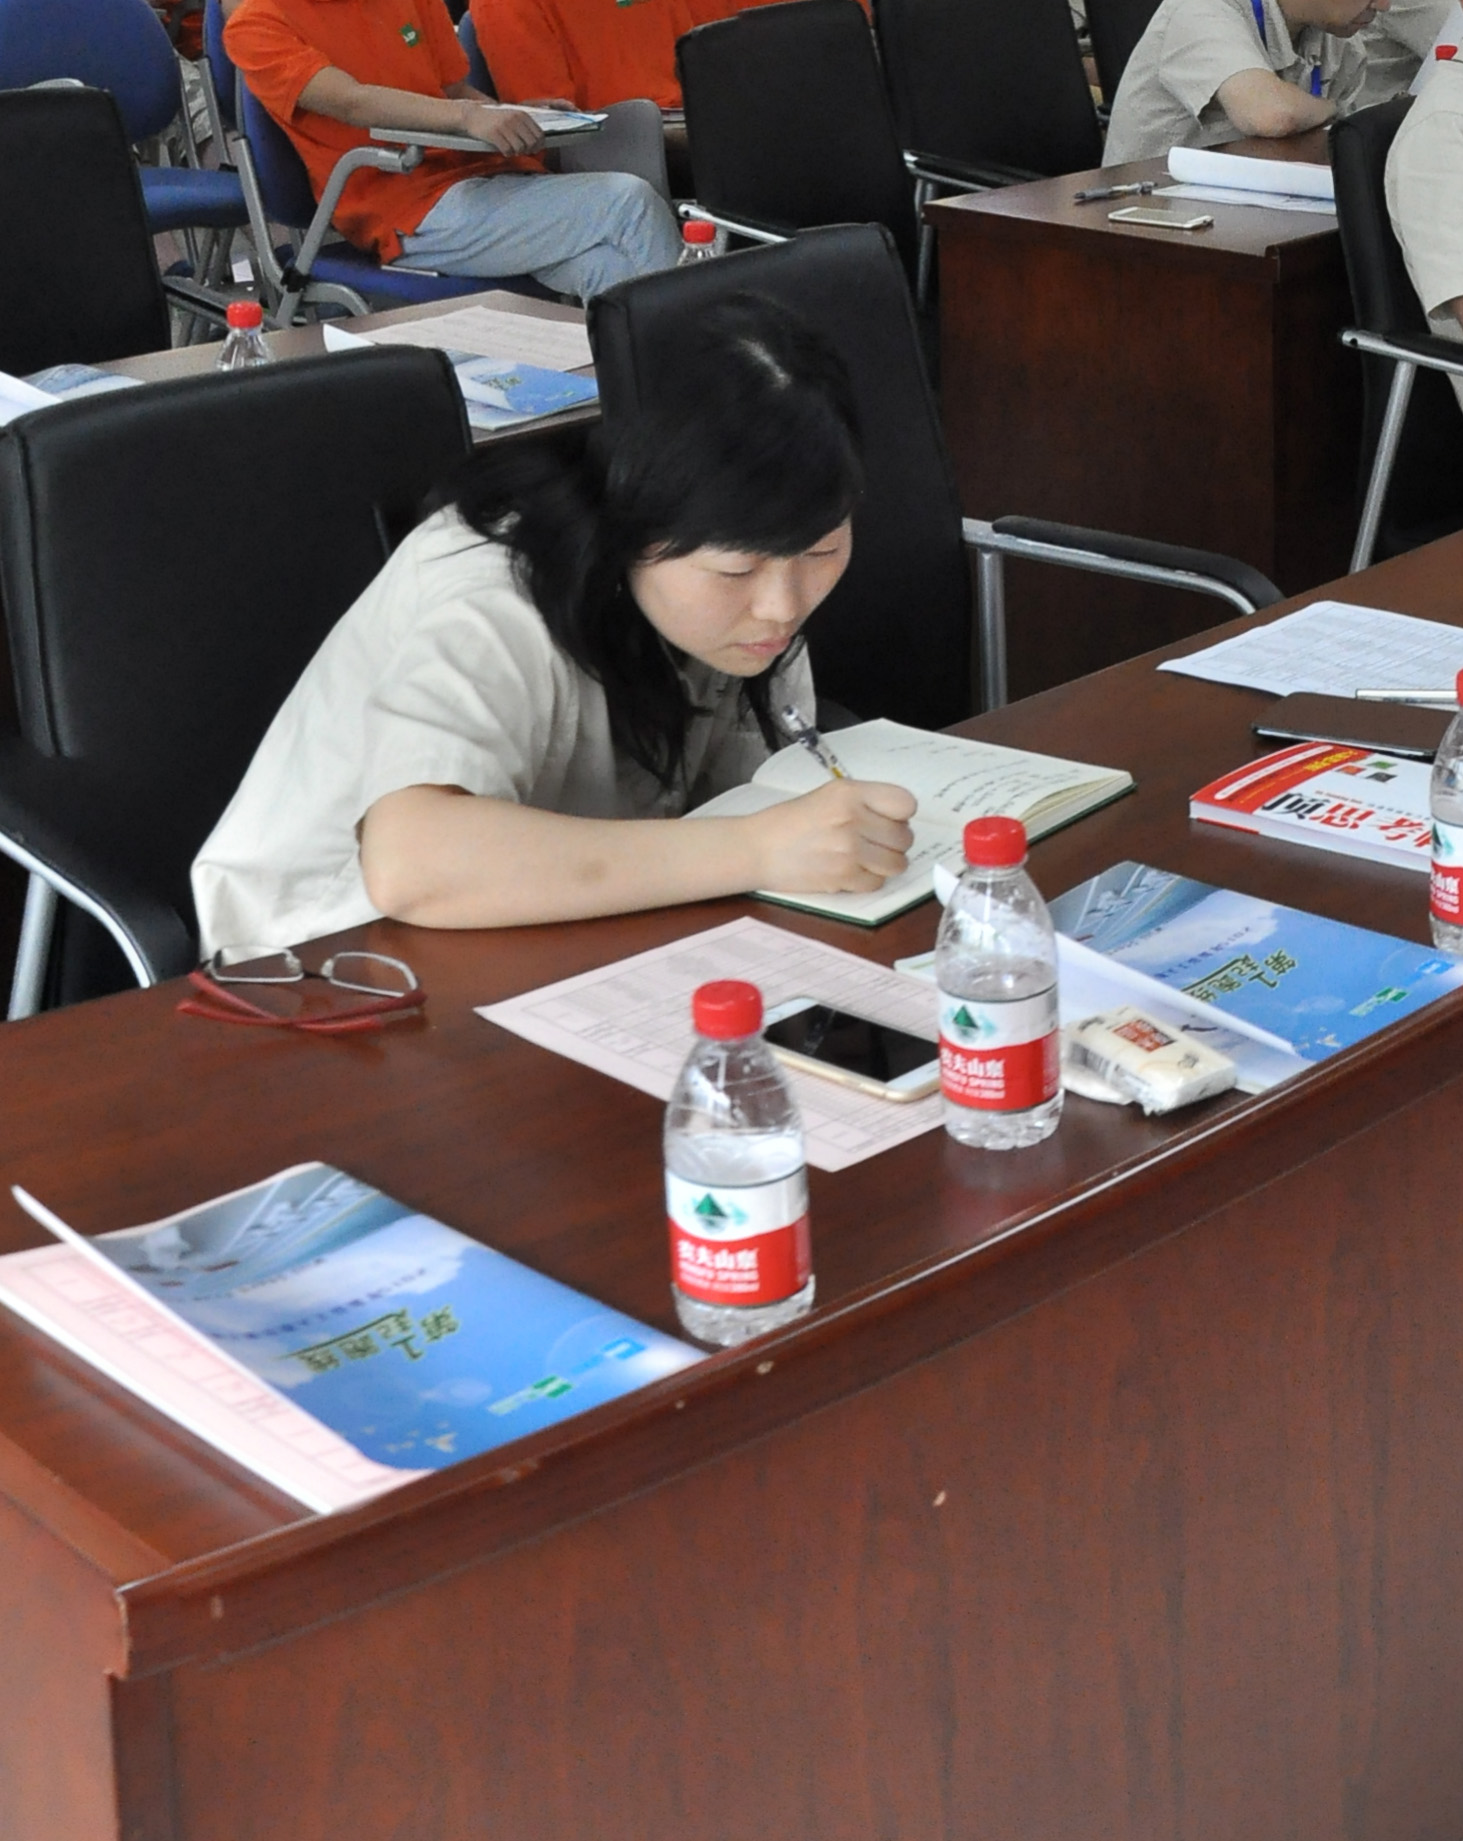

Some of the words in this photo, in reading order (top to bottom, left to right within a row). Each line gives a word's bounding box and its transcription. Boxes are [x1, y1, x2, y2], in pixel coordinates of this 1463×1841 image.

[940, 1047, 1005, 1078] 农夫山泉
[677, 1242, 759, 1273] 农夫山泉
